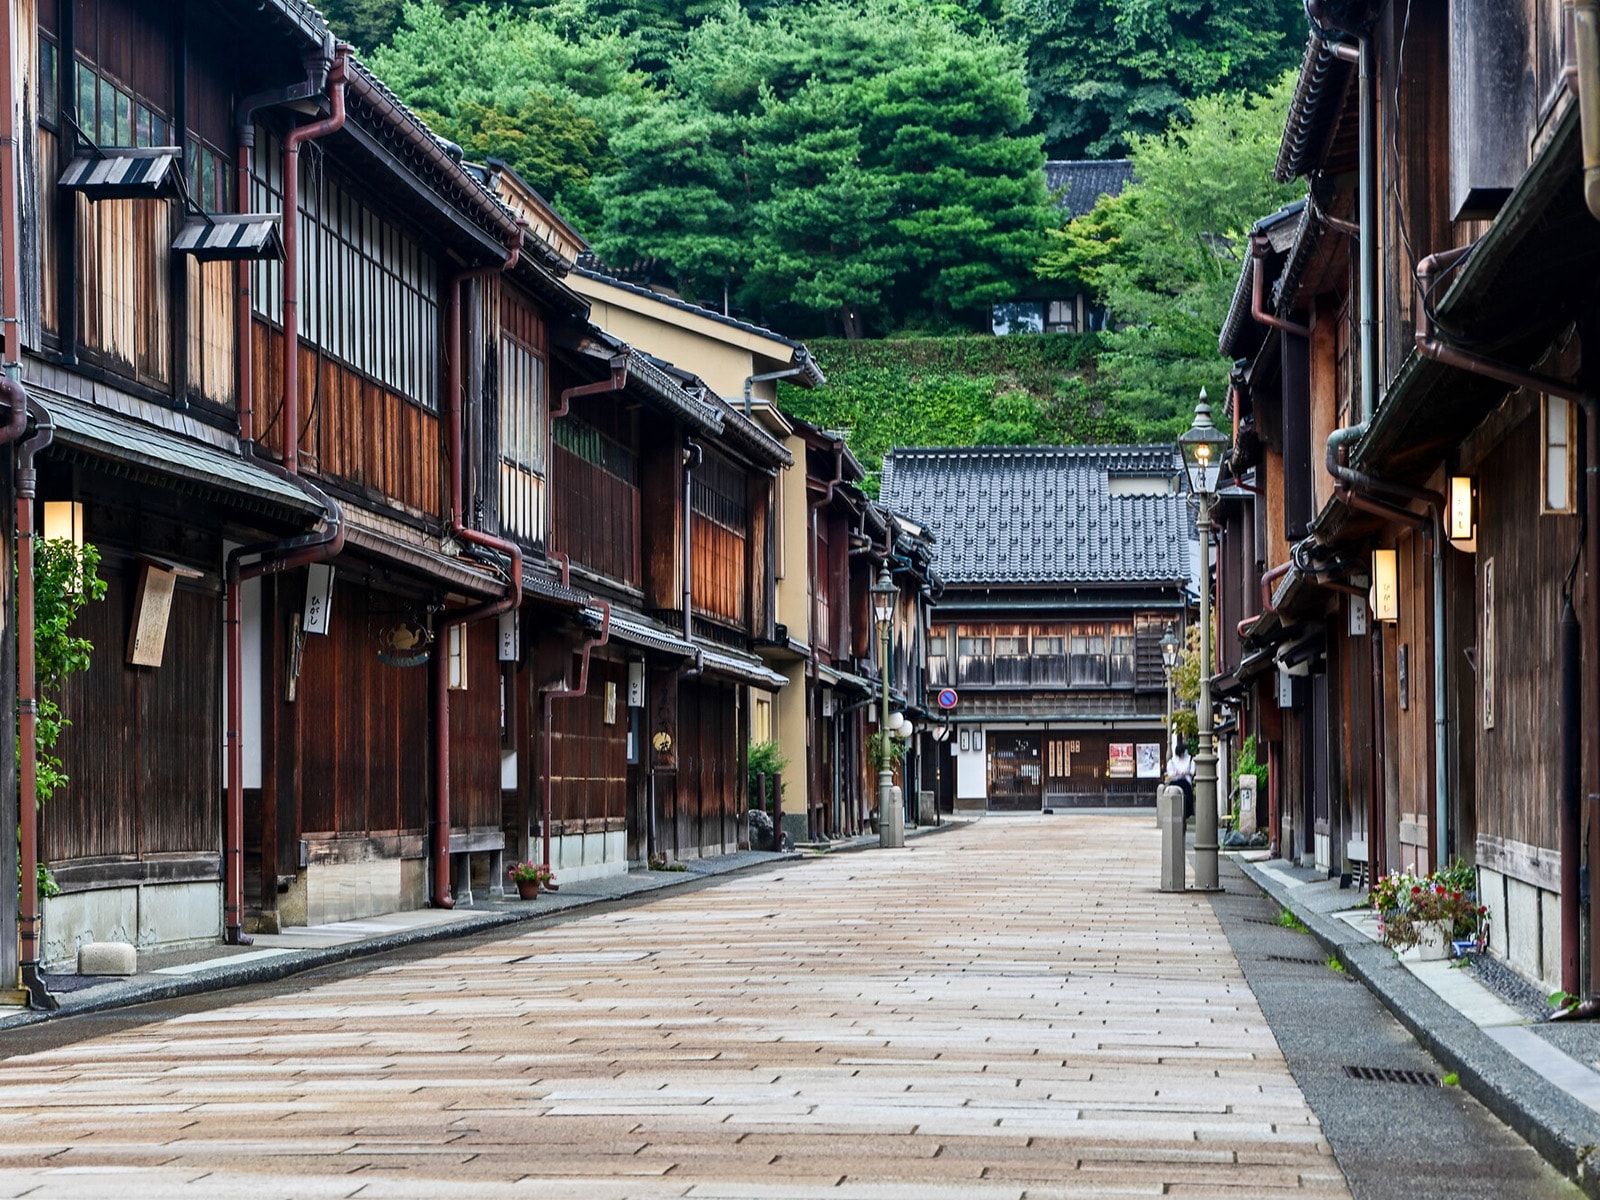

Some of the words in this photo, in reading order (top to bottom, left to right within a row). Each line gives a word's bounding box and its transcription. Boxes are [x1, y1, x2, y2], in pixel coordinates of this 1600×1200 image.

[309, 595, 321, 625] ひがし
[1383, 583, 1391, 613] ひがし
